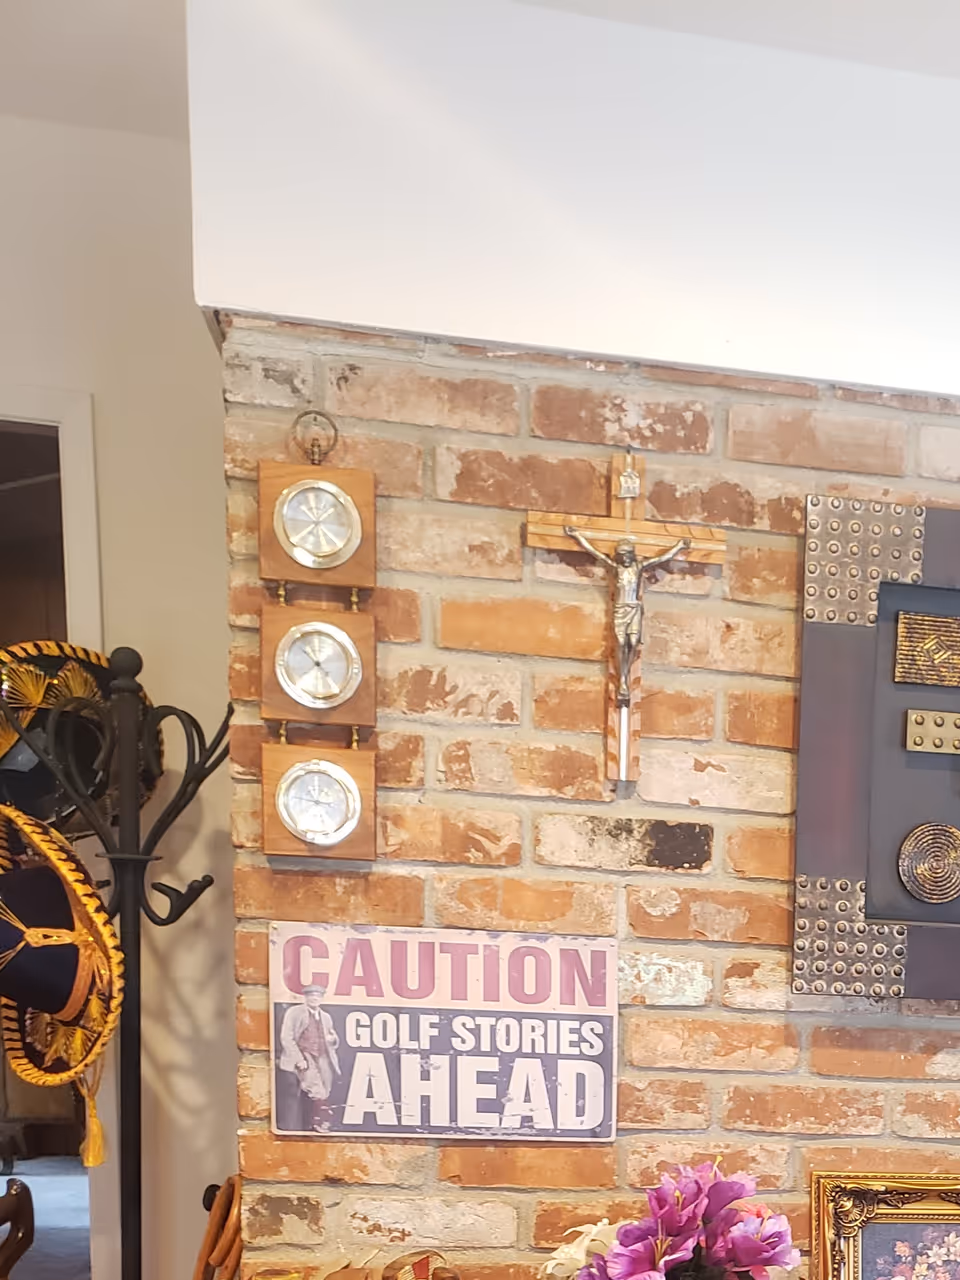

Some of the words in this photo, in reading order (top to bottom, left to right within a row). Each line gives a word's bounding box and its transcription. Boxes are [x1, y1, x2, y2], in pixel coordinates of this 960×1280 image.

[282, 935, 607, 1007] CAUTION
[345, 1011, 440, 1050] GOLF
[450, 1016, 604, 1056] STORIES
[342, 1052, 605, 1130] AHEAD
